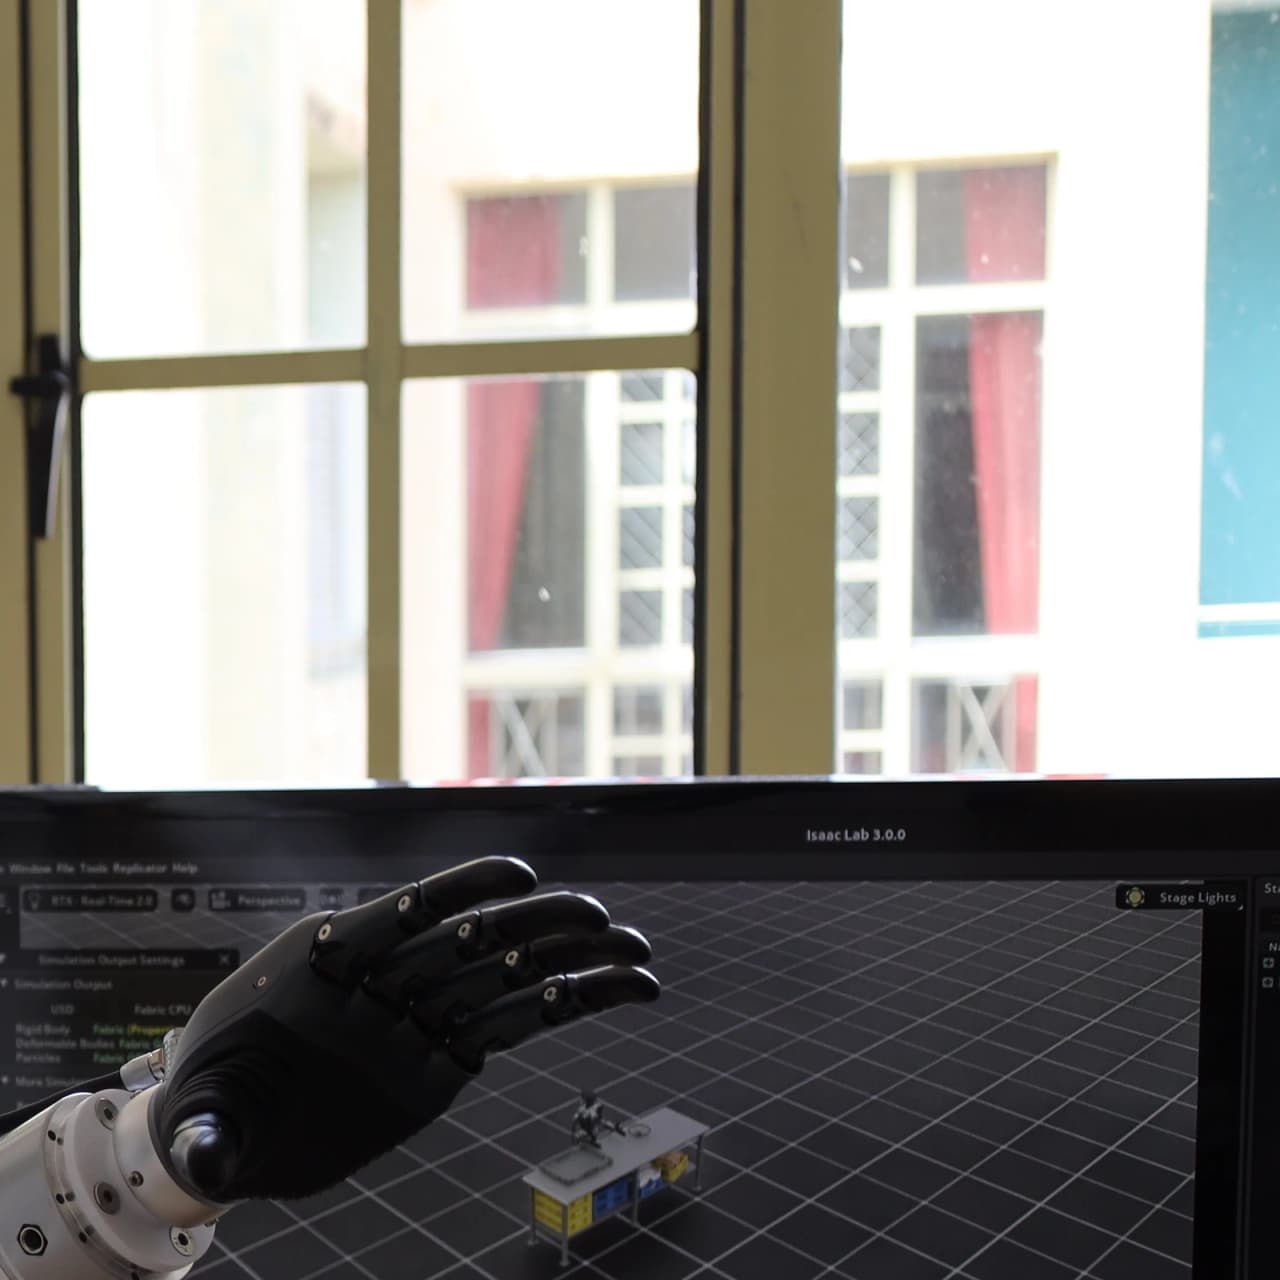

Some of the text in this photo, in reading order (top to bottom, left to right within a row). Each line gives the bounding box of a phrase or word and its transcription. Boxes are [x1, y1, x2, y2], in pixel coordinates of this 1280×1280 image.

[806, 829, 905, 842] Isaac Lab 3.0.0
[9, 861, 51, 874] Window
[56, 861, 74, 874] File
[80, 861, 109, 874] Tools
[112, 861, 168, 876] Replicator
[172, 861, 199, 876] Help
[237, 894, 301, 908] Perspective
[1159, 892, 1237, 906] Stage Lights
[38, 953, 184, 968] Simulation Output Settings
[14, 978, 112, 992] Simulation Output
[134, 1003, 166, 1016] Fabric
